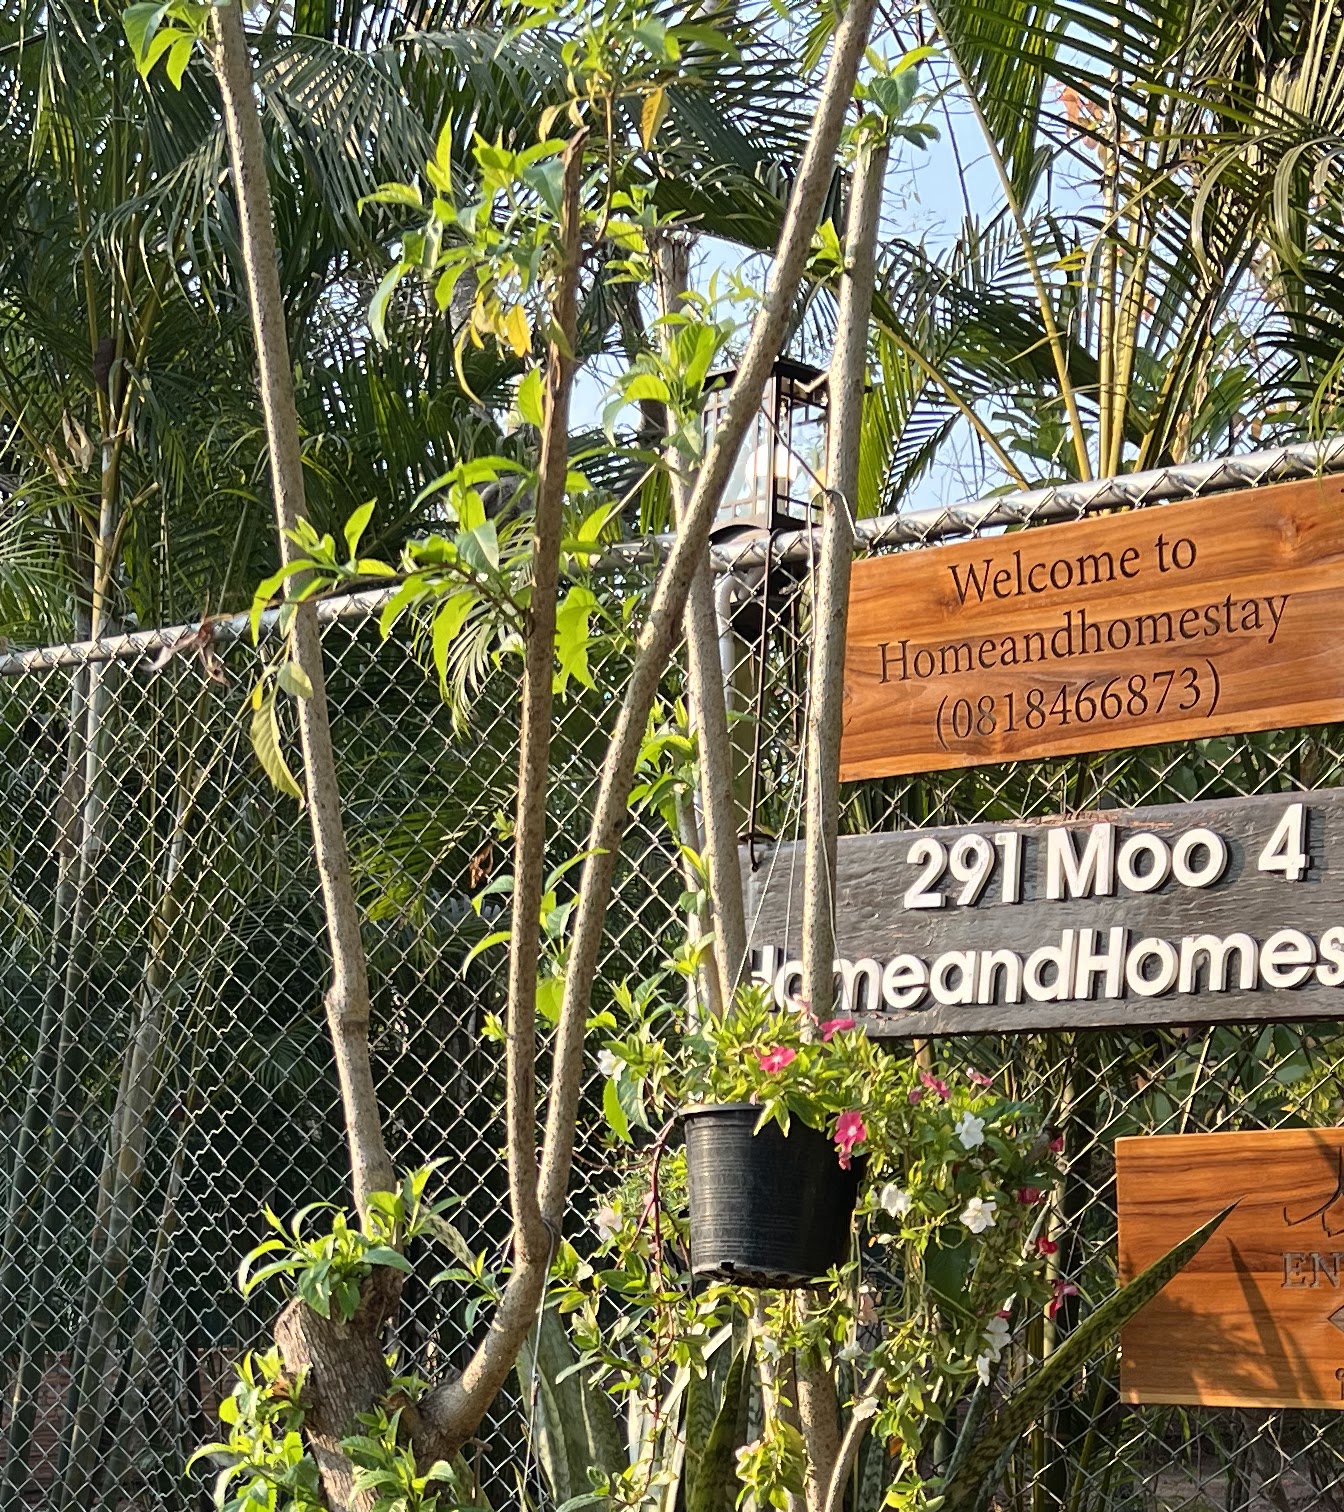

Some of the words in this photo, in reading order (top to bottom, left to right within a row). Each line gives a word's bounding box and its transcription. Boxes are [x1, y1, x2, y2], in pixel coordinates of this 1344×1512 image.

[947, 548, 1141, 607] Welcome
[1154, 532, 1198, 573] to
[878, 592, 1292, 685] Homeandhomestay
[935, 658, 1222, 752] (0818466873)
[903, 832, 1023, 911] 291
[1045, 822, 1229, 901] Moo
[1258, 802, 1312, 882] 4
